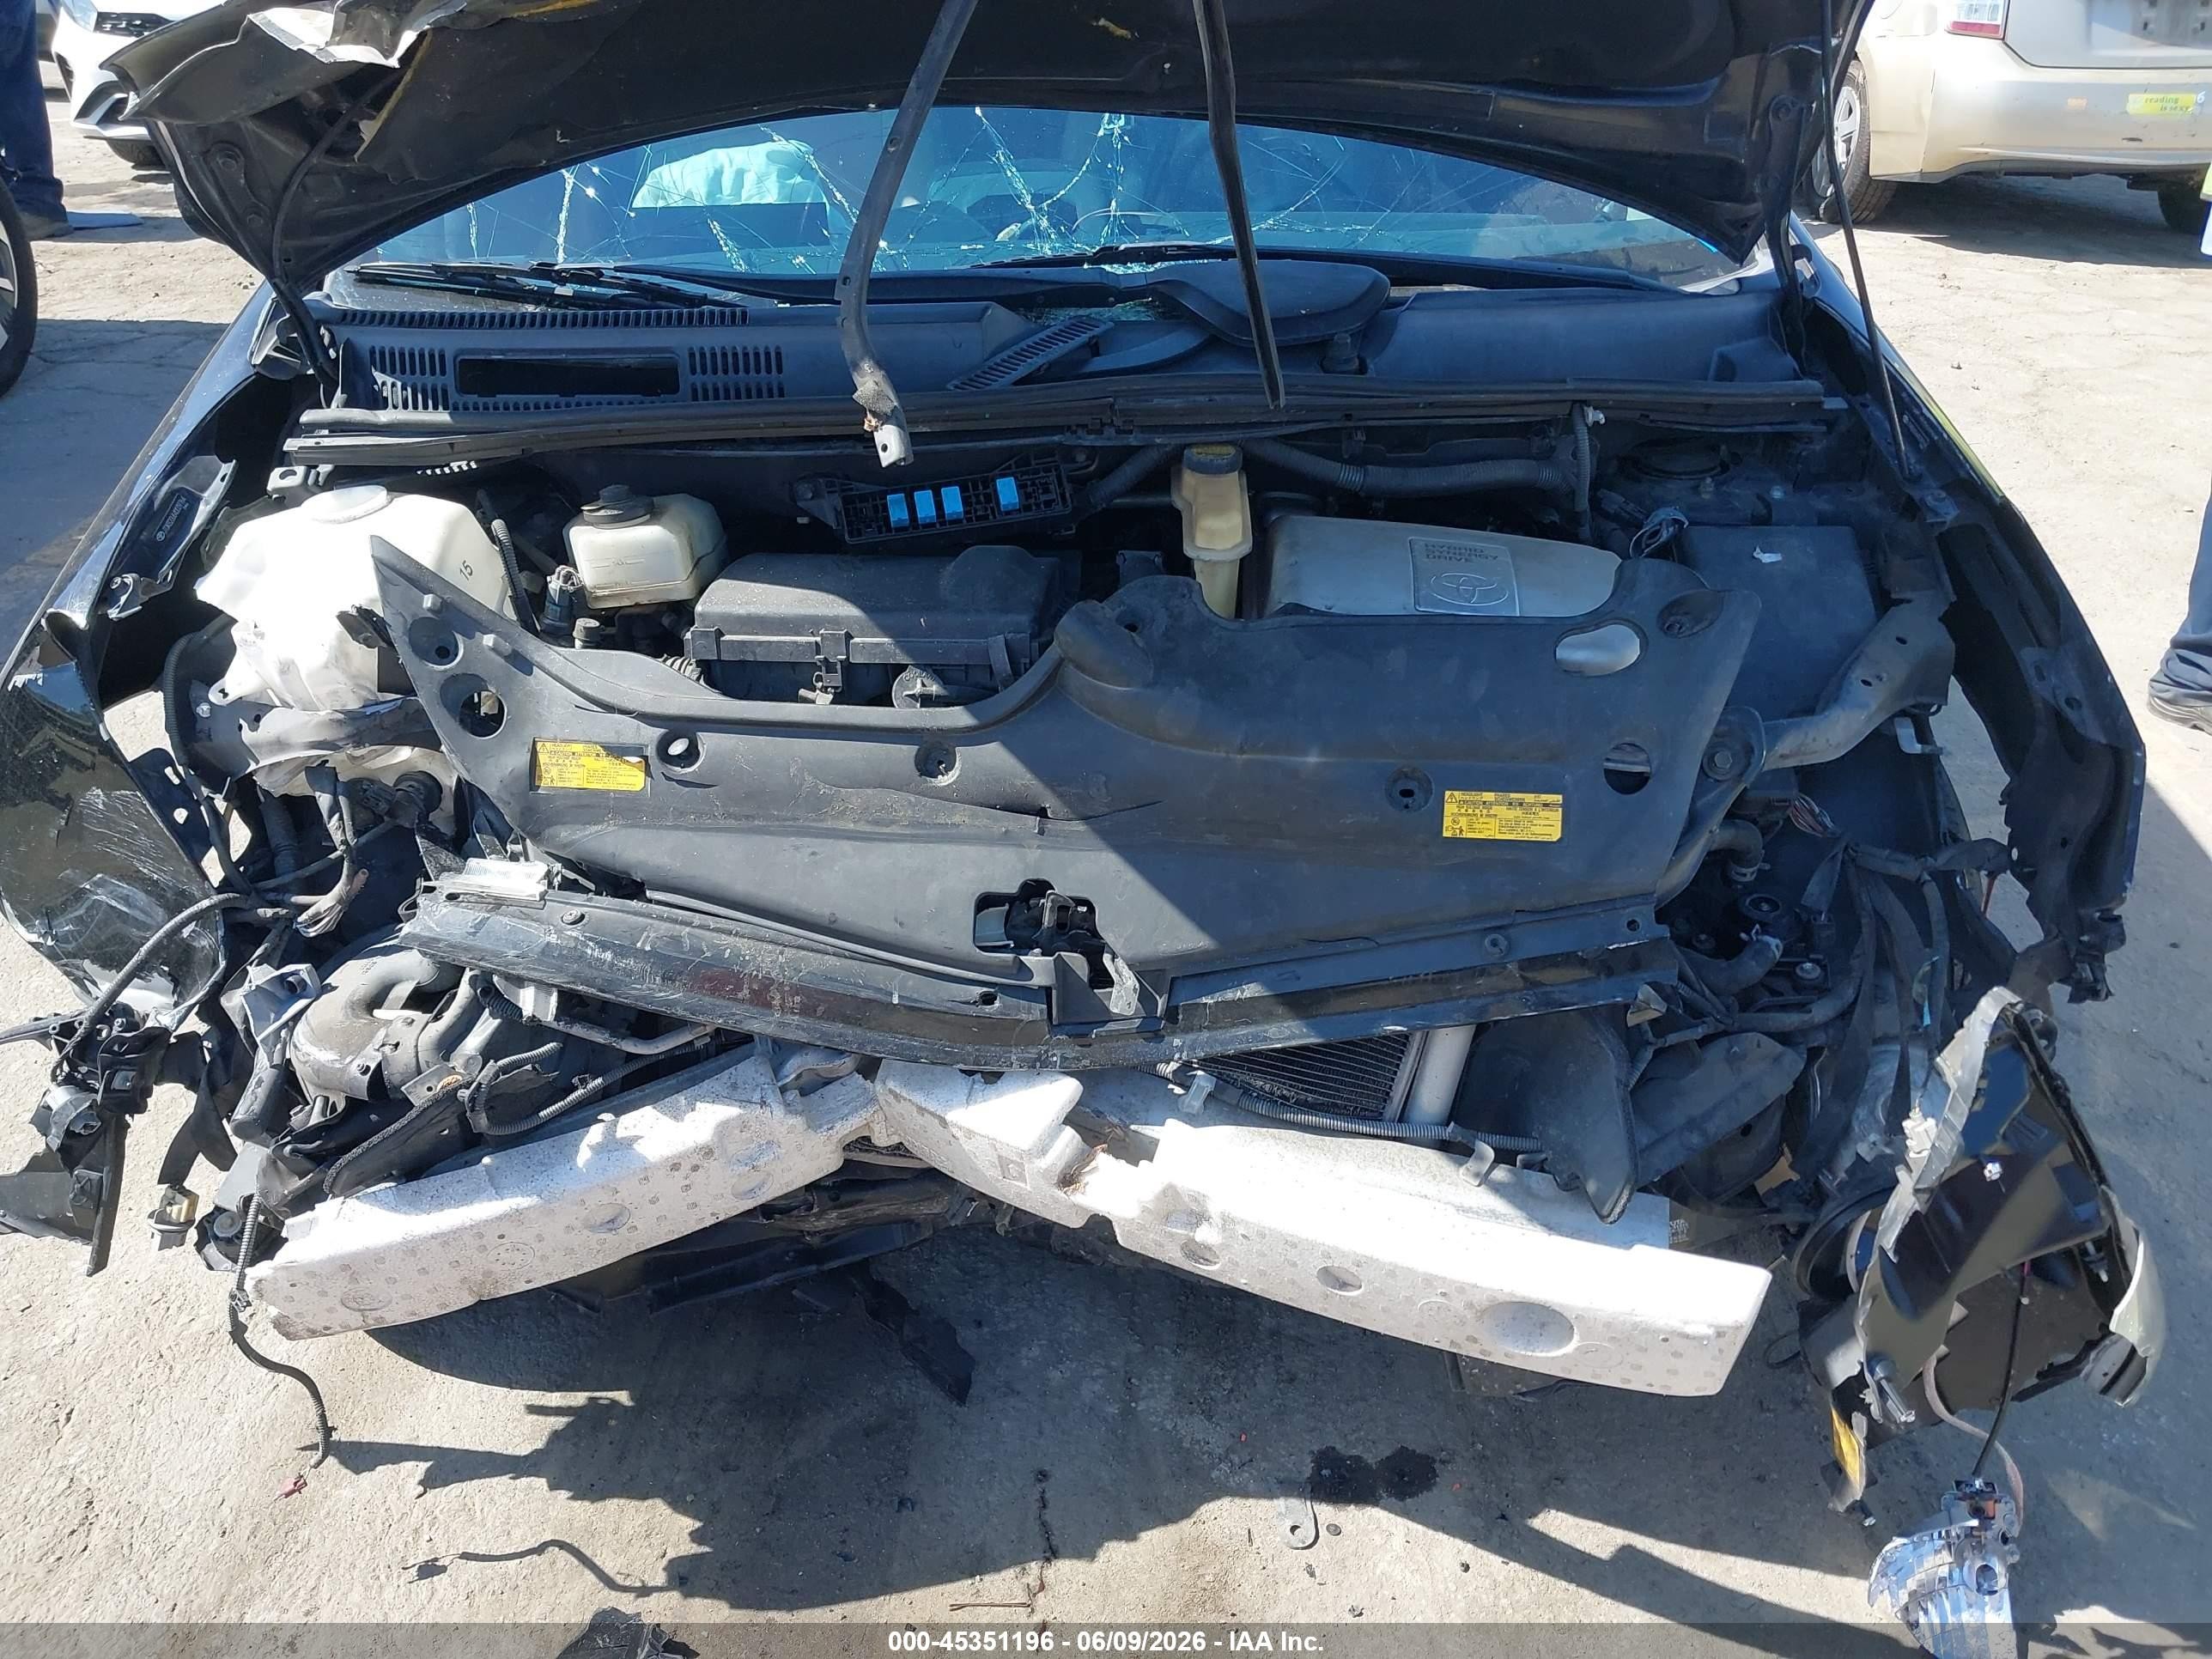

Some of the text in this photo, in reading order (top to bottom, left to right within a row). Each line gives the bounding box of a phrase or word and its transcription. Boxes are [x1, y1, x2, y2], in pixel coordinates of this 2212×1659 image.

[2145, 95, 2179, 105] reading
[1425, 543, 1485, 553] HYBRID
[1425, 549, 1498, 561] SYNERGY
[459, 560, 474, 581] 15
